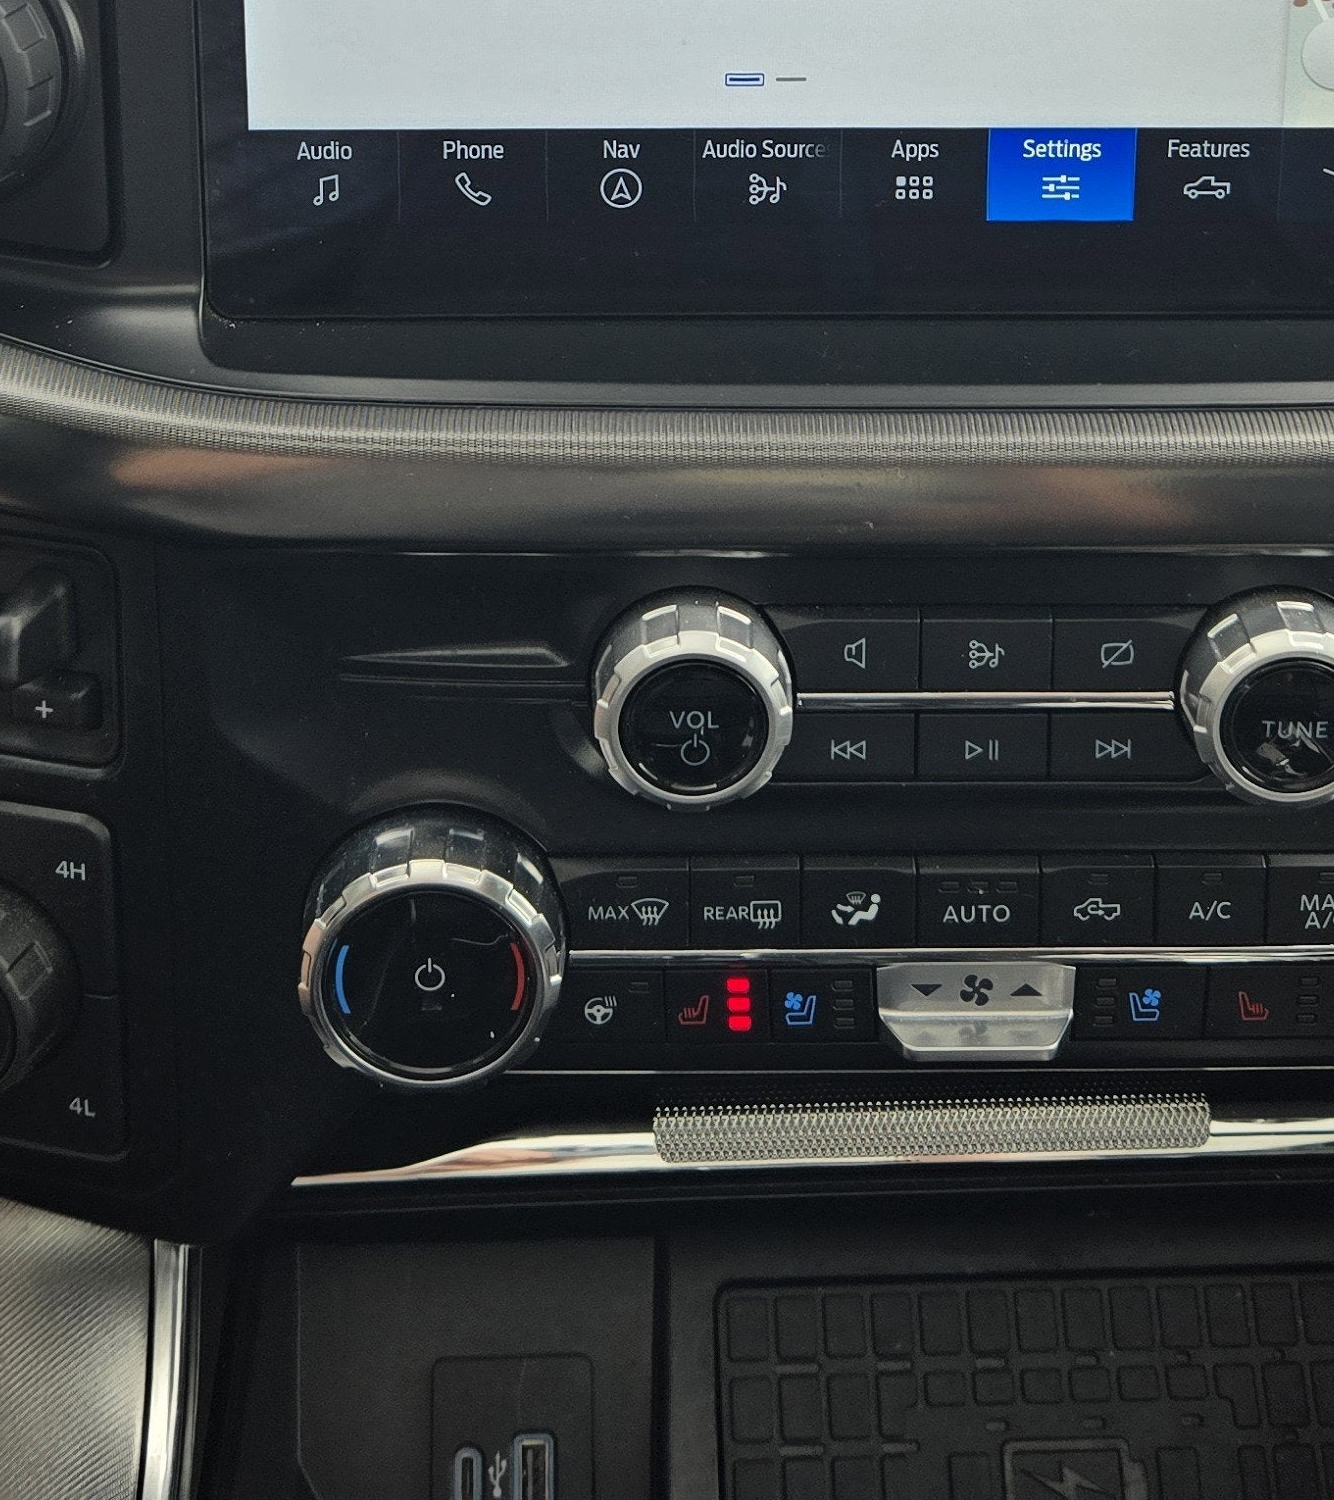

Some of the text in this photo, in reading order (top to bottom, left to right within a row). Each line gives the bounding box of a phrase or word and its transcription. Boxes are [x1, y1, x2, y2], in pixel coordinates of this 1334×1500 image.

[297, 140, 352, 161] Audio
[442, 140, 505, 161] Phone
[602, 140, 641, 160] Nav
[702, 139, 758, 161] Audio
[890, 139, 940, 164] Apps
[1022, 138, 1103, 164] Settings
[1167, 138, 1250, 161] Features
[669, 710, 719, 732] VOL
[1261, 719, 1329, 741] TUNE
[55, 860, 87, 881] 4H
[588, 904, 630, 921] MAX
[703, 904, 749, 922] REAR
[942, 904, 1010, 923] AUTO
[1188, 900, 1232, 921] A/C
[69, 1097, 96, 1118] 4L
